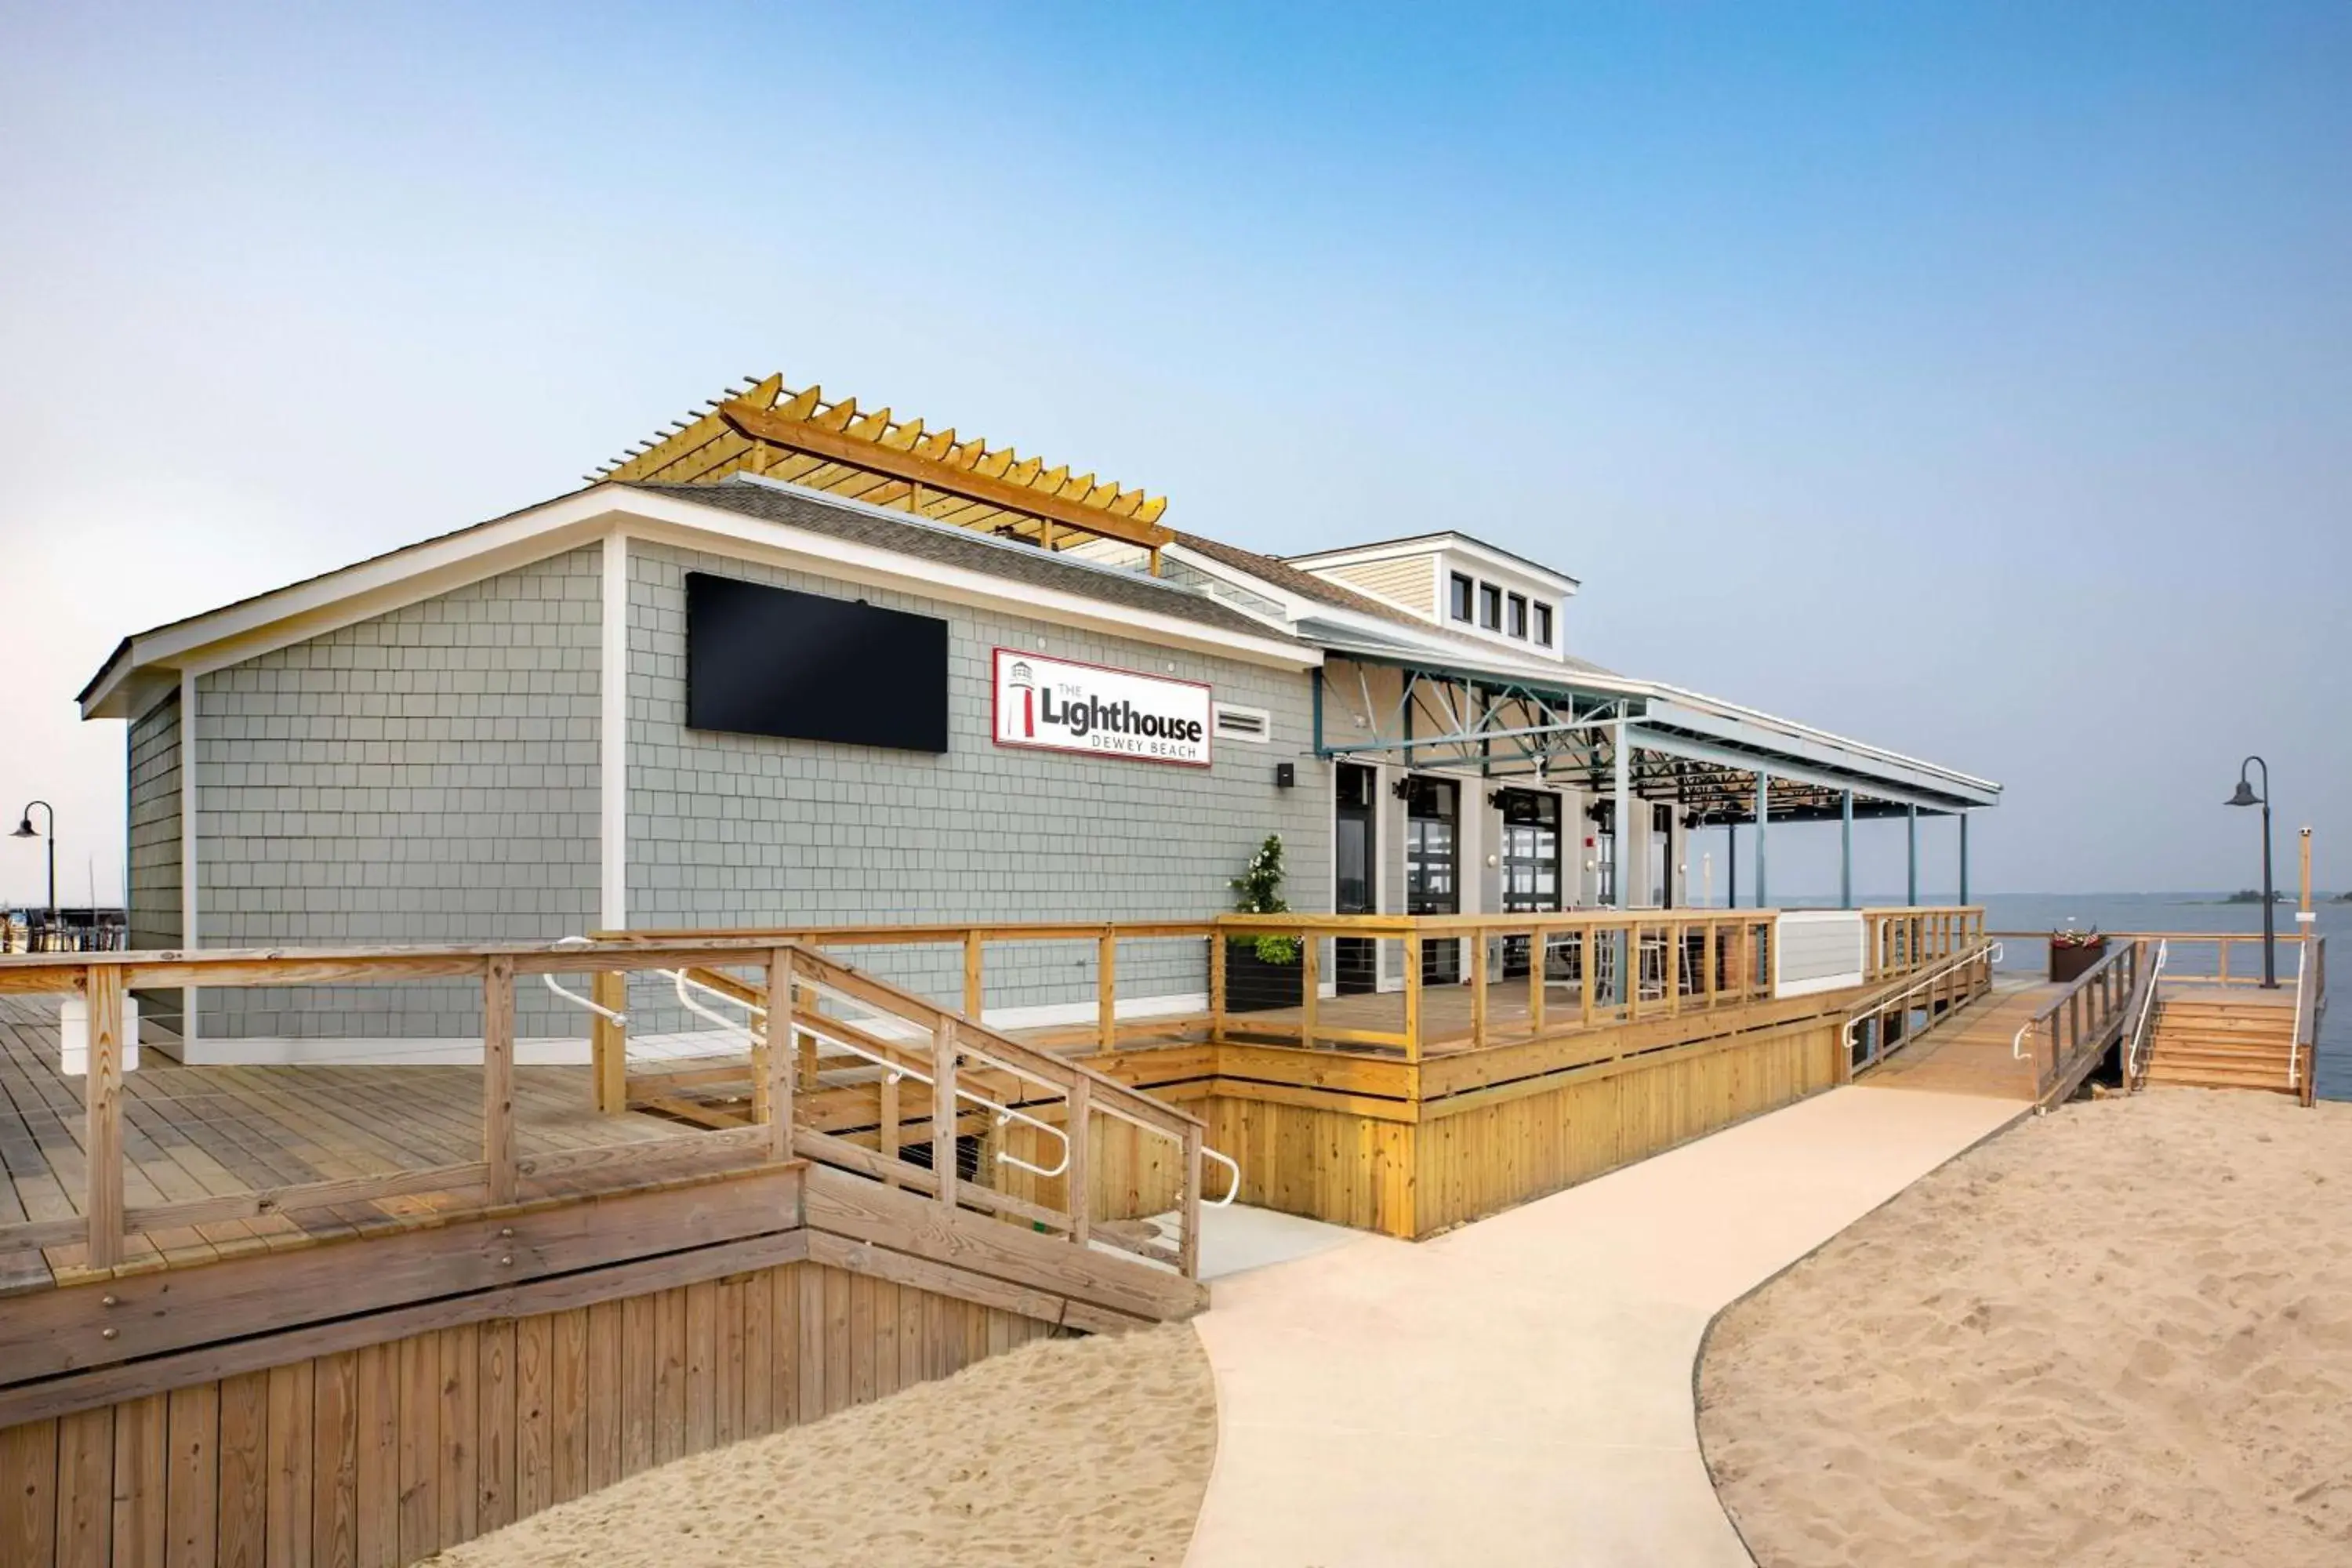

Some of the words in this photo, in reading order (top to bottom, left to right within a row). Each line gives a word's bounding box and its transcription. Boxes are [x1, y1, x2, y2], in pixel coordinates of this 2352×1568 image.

[1058, 684, 1083, 697] THE
[1042, 688, 1202, 742] Lighthouse
[1092, 735, 1143, 752] DEWEY
[1150, 742, 1196, 757] BEACH
